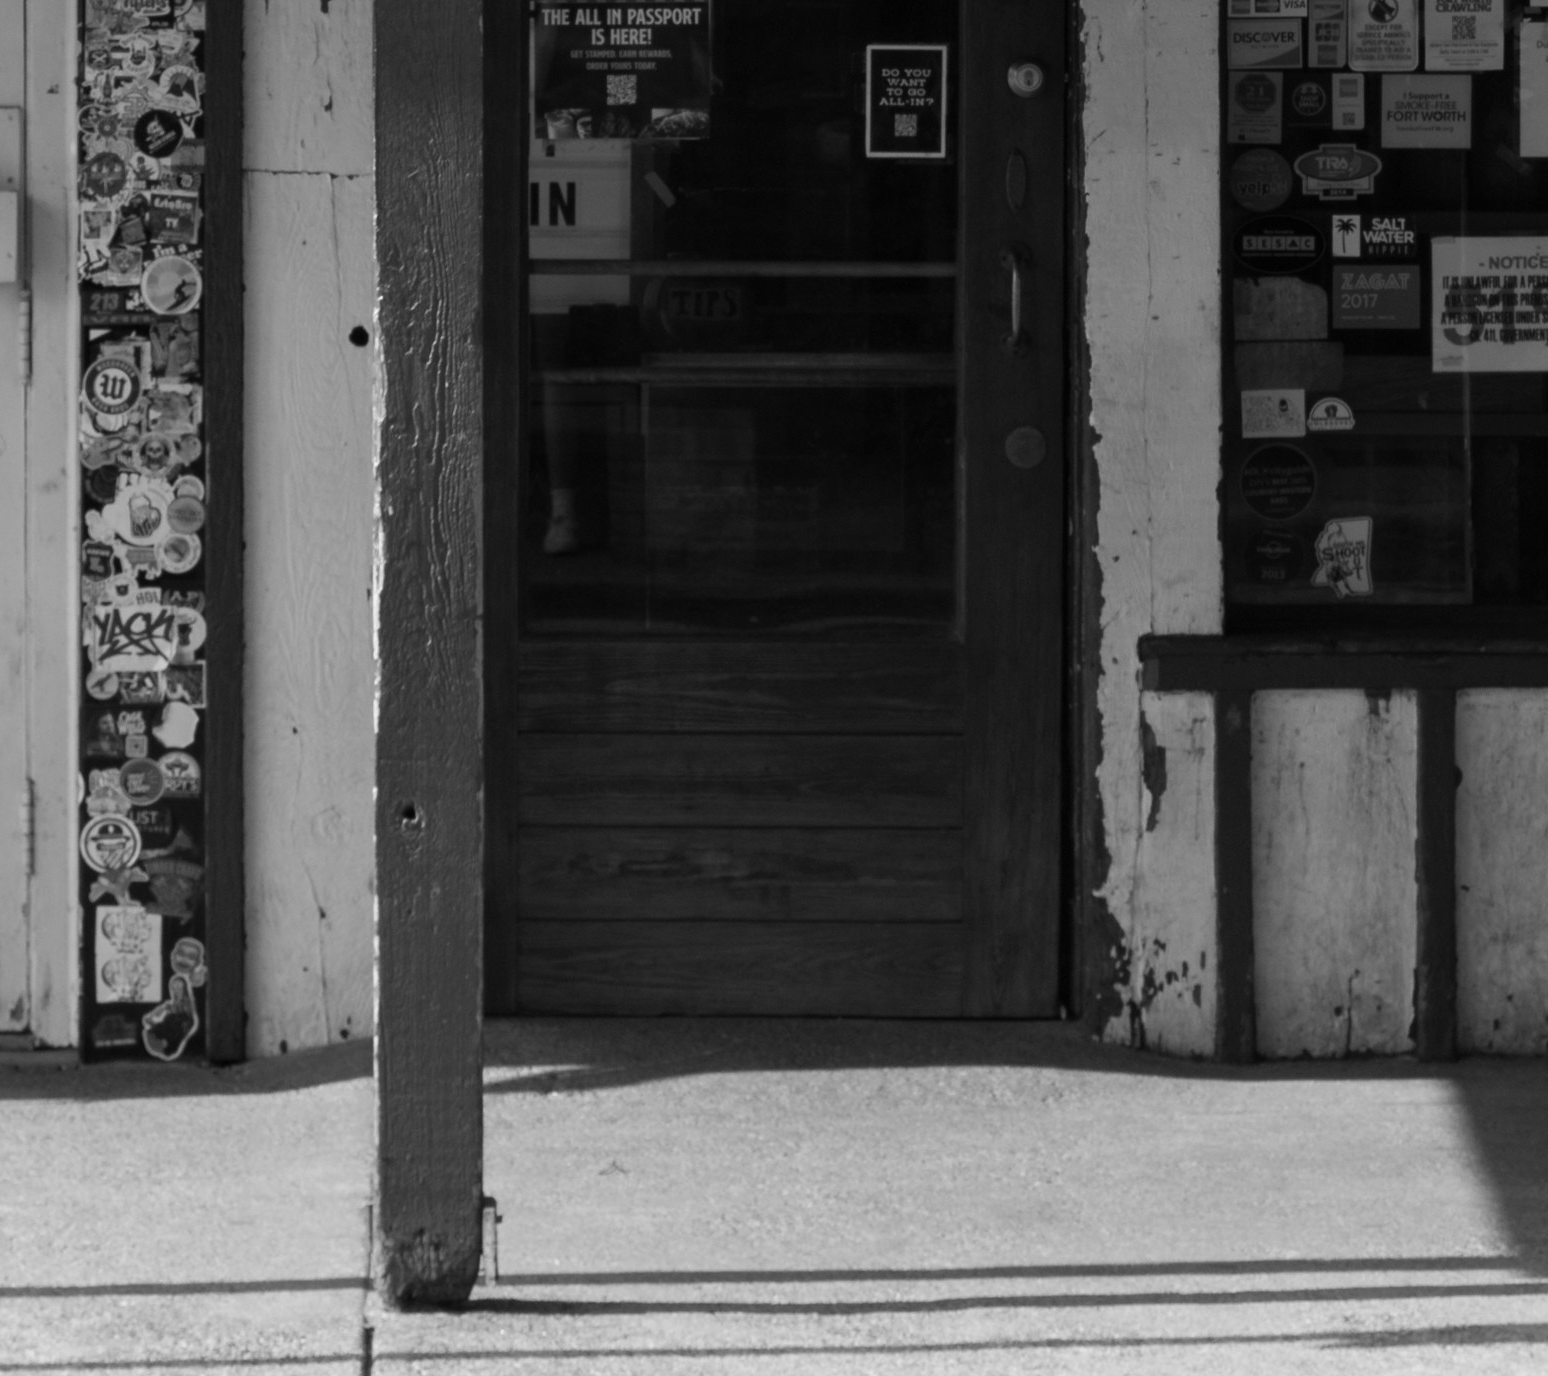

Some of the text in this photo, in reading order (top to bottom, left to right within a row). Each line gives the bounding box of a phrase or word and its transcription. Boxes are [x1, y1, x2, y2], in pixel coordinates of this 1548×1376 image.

[1283, 0, 1305, 8] VISA
[541, 8, 701, 26] THE ALL IN PASSPORT
[591, 29, 652, 46] IS HERE!
[1233, 31, 1295, 44] DISCOVER
[881, 68, 932, 77] DO YOU
[887, 78, 917, 87] WANT
[886, 88, 926, 96] TO GO
[1387, 111, 1466, 122] FORT WORTH
[1371, 218, 1406, 231] SALT
[1363, 231, 1415, 244] WATER
[1489, 256, 1545, 269] NOTICE
[1341, 273, 1410, 289] ZAGAT
[1342, 293, 1378, 308] 2017
